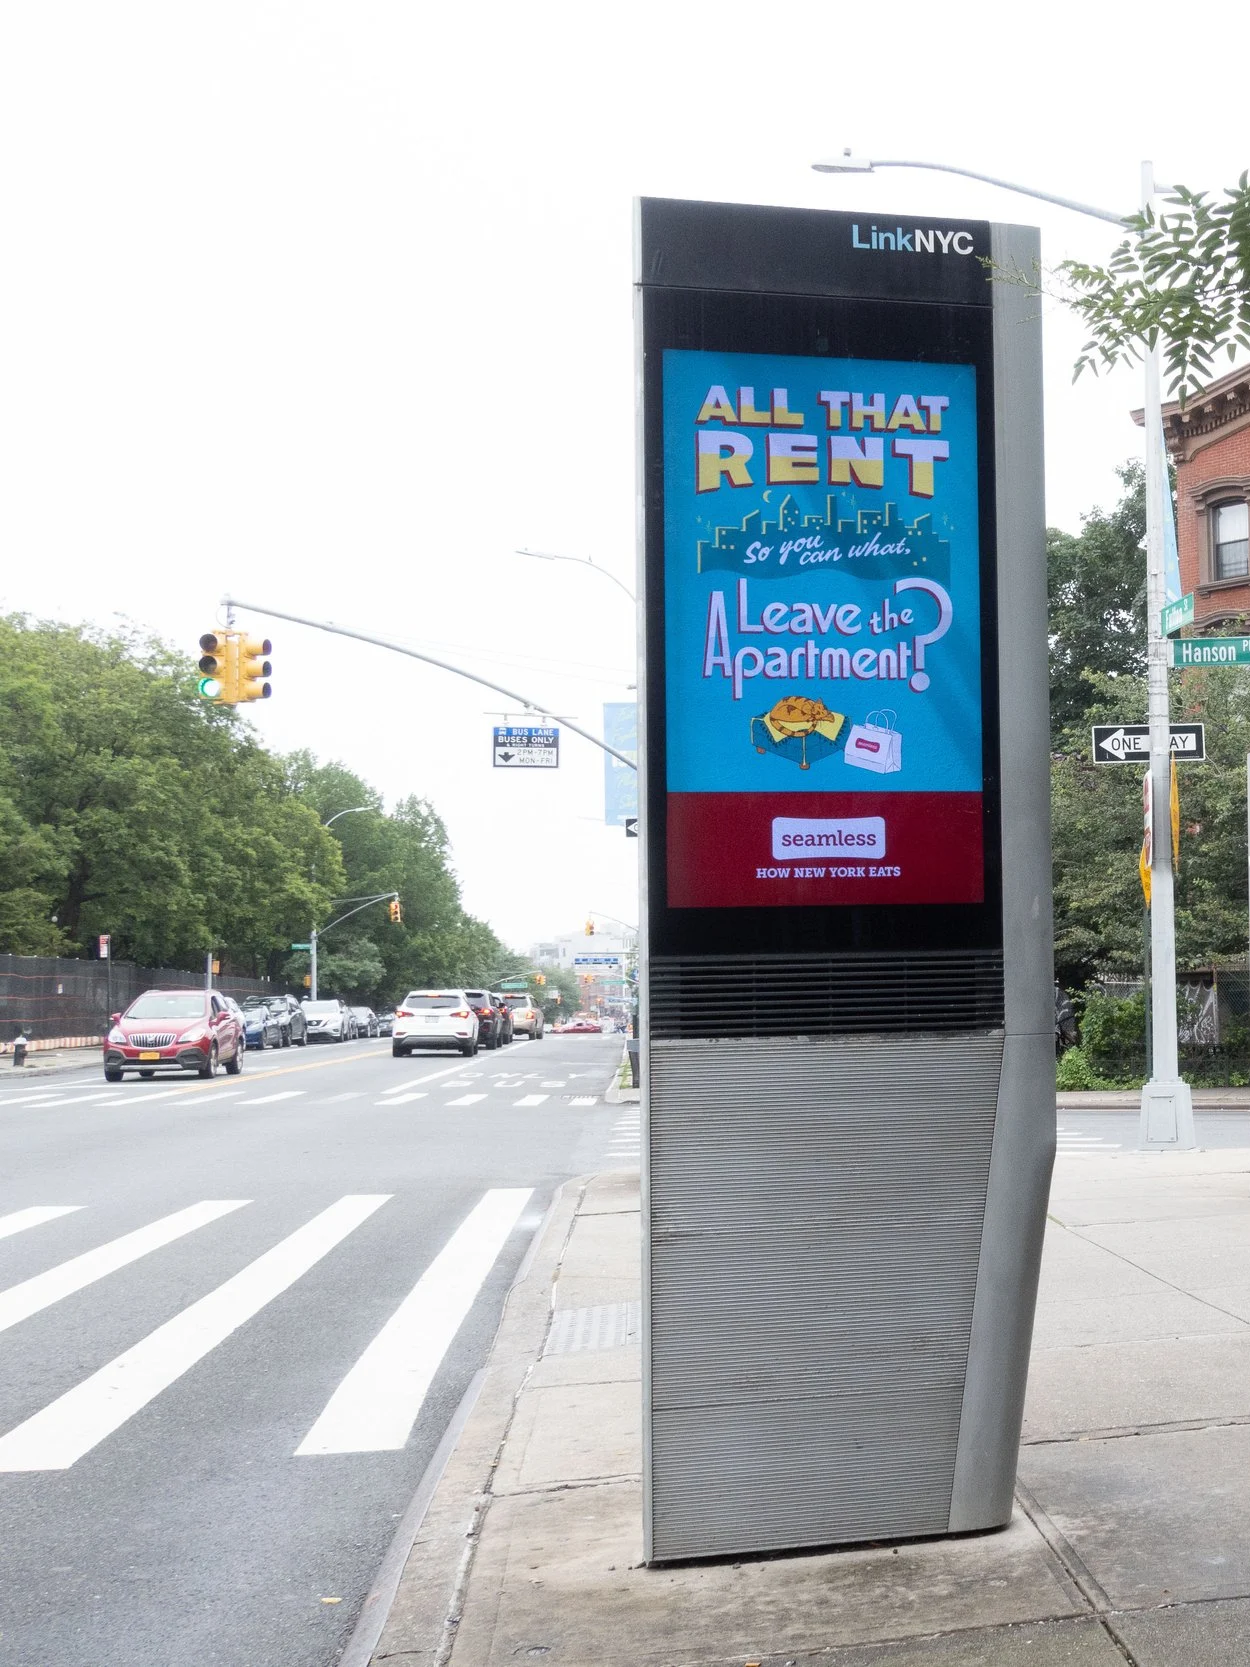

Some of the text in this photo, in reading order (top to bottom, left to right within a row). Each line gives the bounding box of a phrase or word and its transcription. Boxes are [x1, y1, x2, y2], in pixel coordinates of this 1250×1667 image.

[852, 223, 975, 255] LinkNYC
[695, 384, 950, 434] ALL THAT
[695, 430, 950, 499] RENT
[743, 532, 911, 566] So you can what,
[737, 577, 915, 636] Leave the
[1182, 642, 1237, 663] Hanson
[511, 728, 554, 736] BUS LANE
[531, 736, 555, 744] ONLY
[1111, 735, 1189, 751] ONE AY
[781, 830, 877, 847] seamless
[755, 866, 901, 879] HOW NEW YORK EATS
